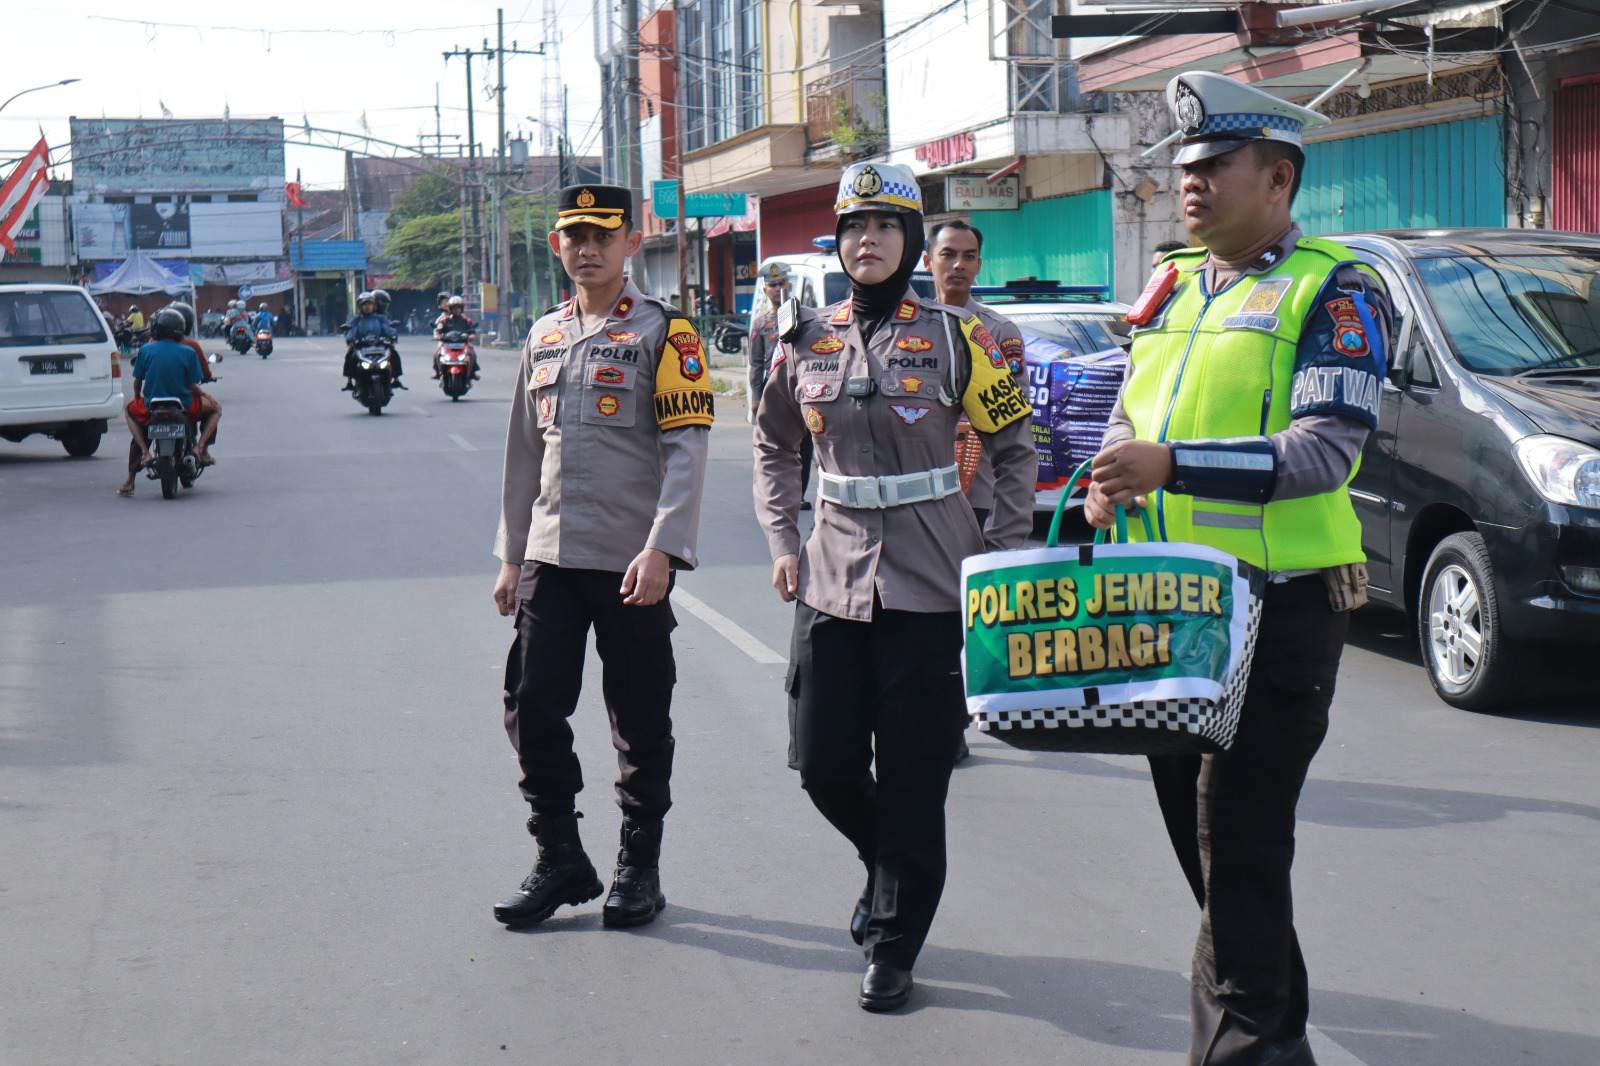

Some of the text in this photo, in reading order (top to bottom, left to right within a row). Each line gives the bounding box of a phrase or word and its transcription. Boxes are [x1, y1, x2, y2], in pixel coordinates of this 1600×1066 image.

[927, 139, 949, 168] BALI
[949, 131, 975, 163] MAS
[955, 186, 1014, 199] BALI MAS
[590, 346, 639, 363] POLRI
[888, 357, 938, 369] POLRI
[802, 361, 840, 372] ARUM
[967, 571, 1222, 629] POLRES JEMBER
[1007, 622, 1173, 679] BERBAGI
